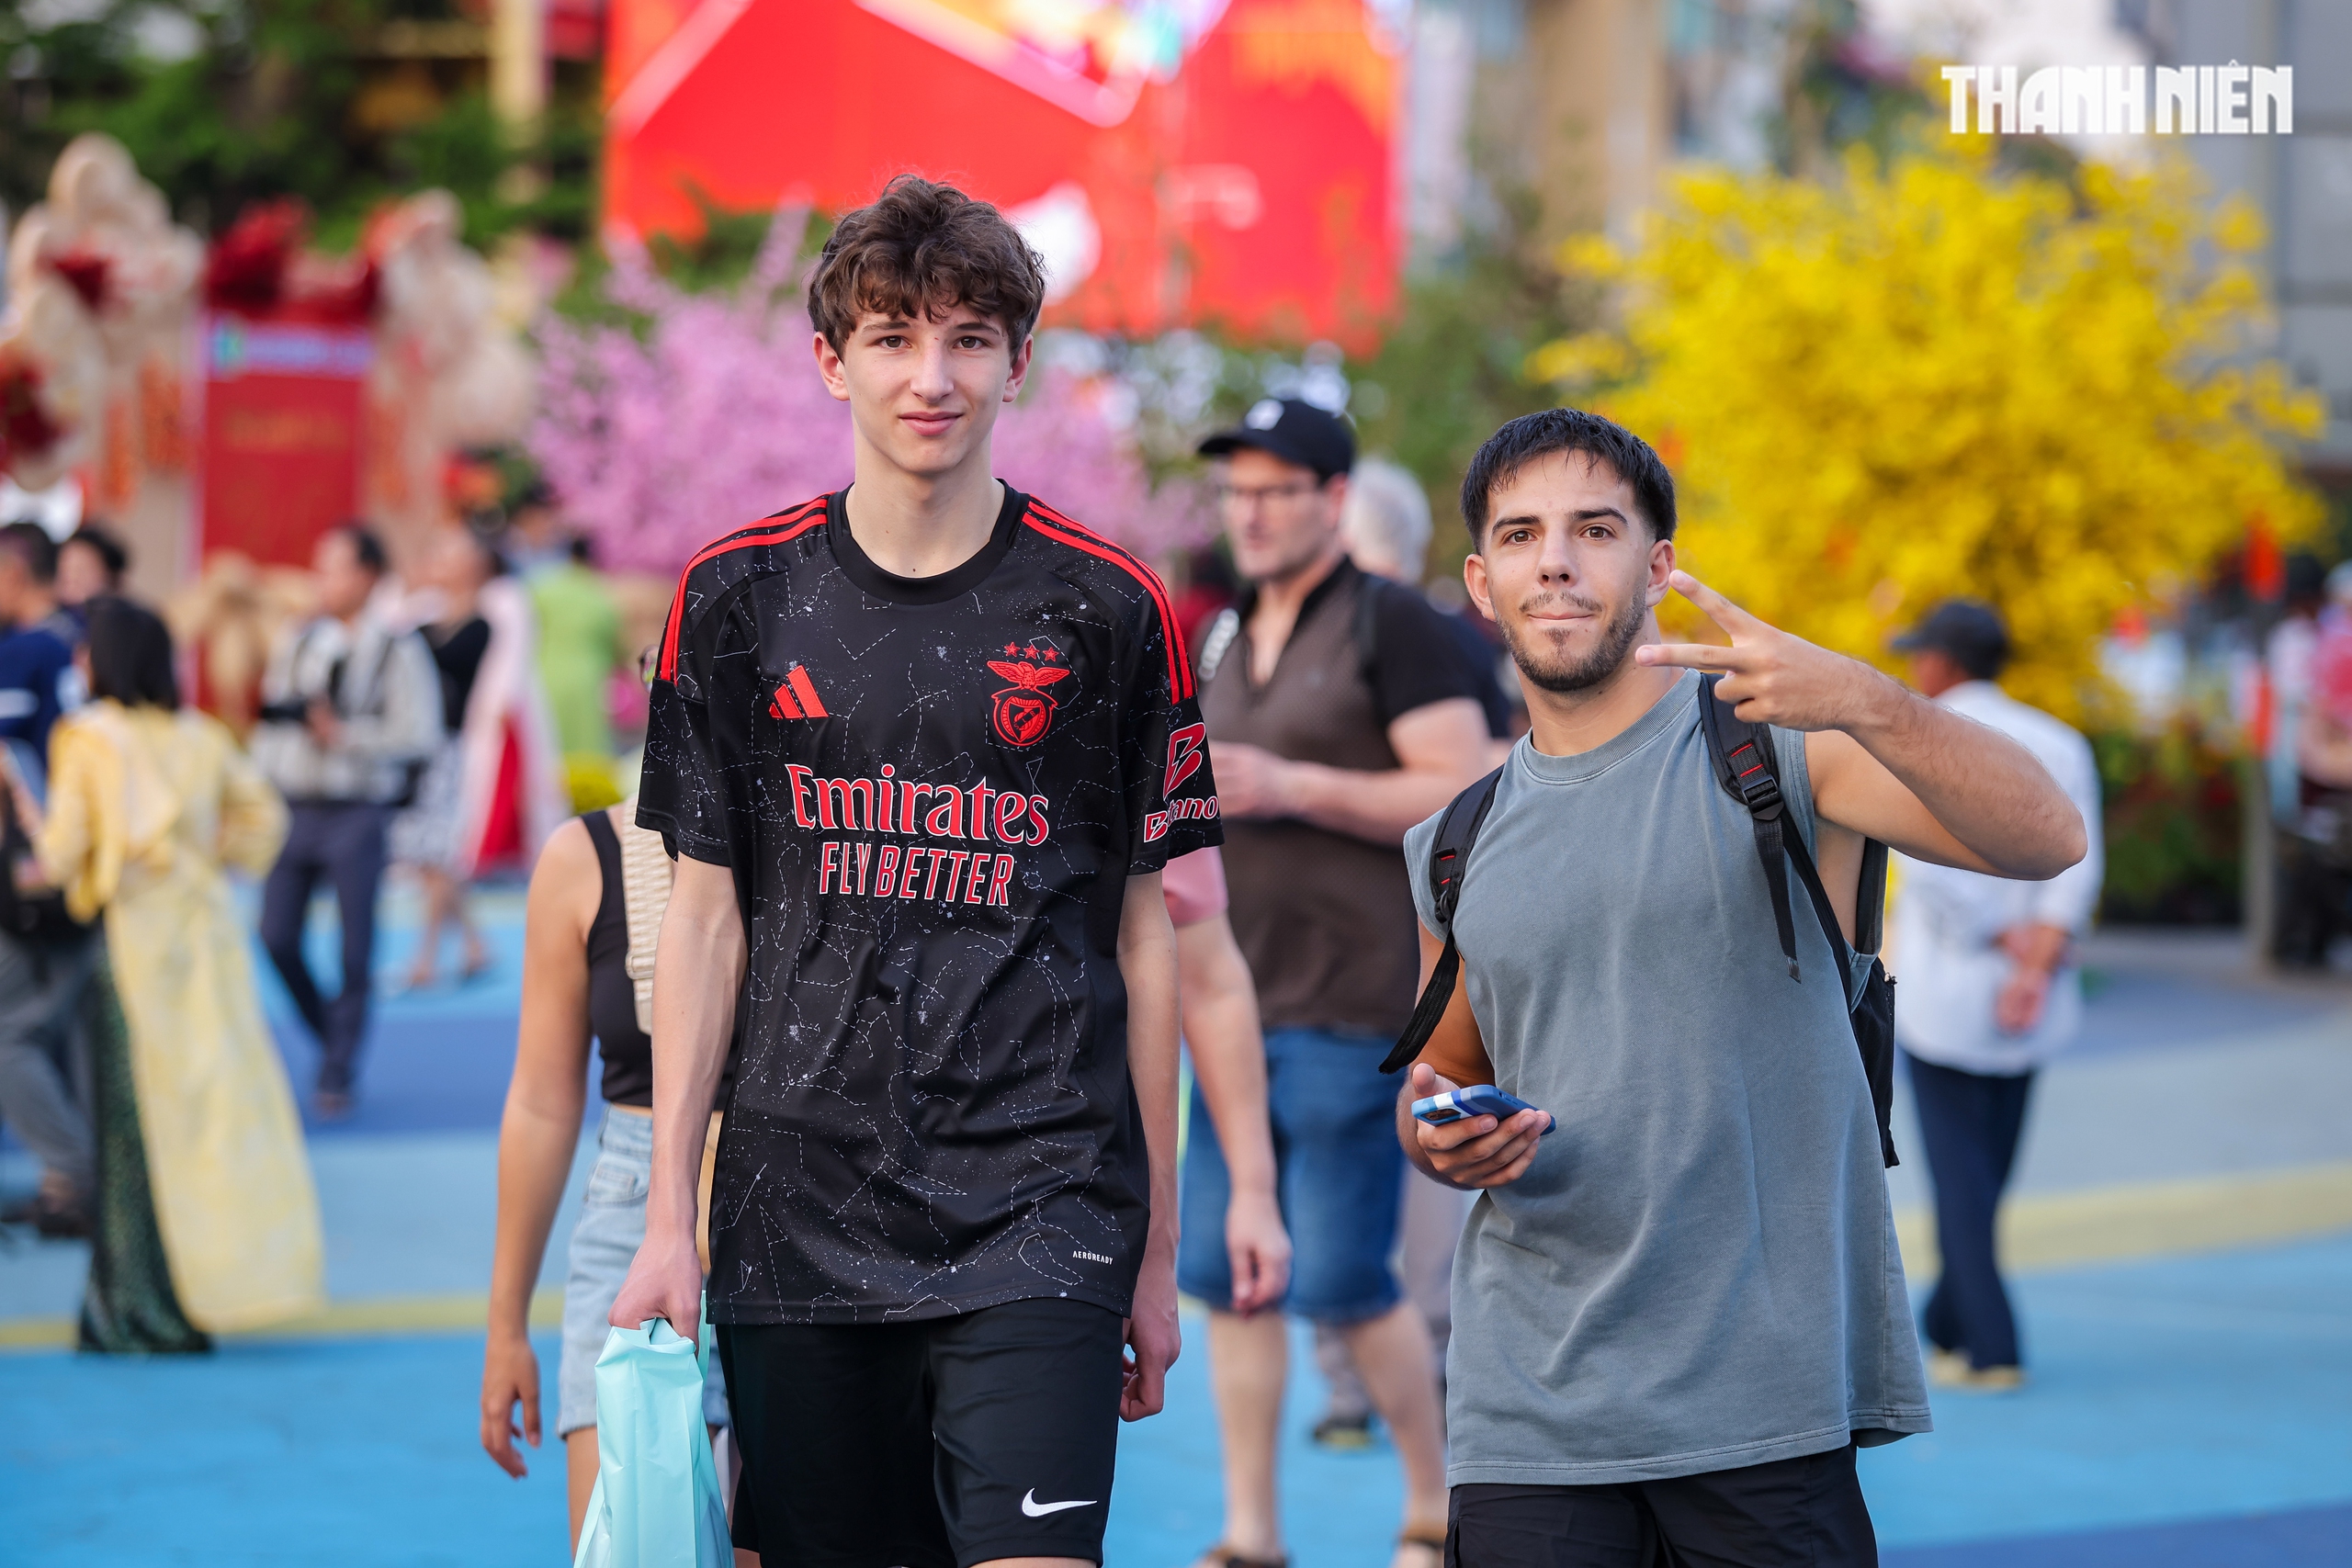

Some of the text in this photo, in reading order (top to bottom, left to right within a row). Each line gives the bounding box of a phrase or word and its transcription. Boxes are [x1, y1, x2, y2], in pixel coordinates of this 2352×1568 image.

[785, 763, 1049, 846] Emirates
[1143, 795, 1219, 843] Btano
[1072, 1250, 1114, 1265] AEROREADY
